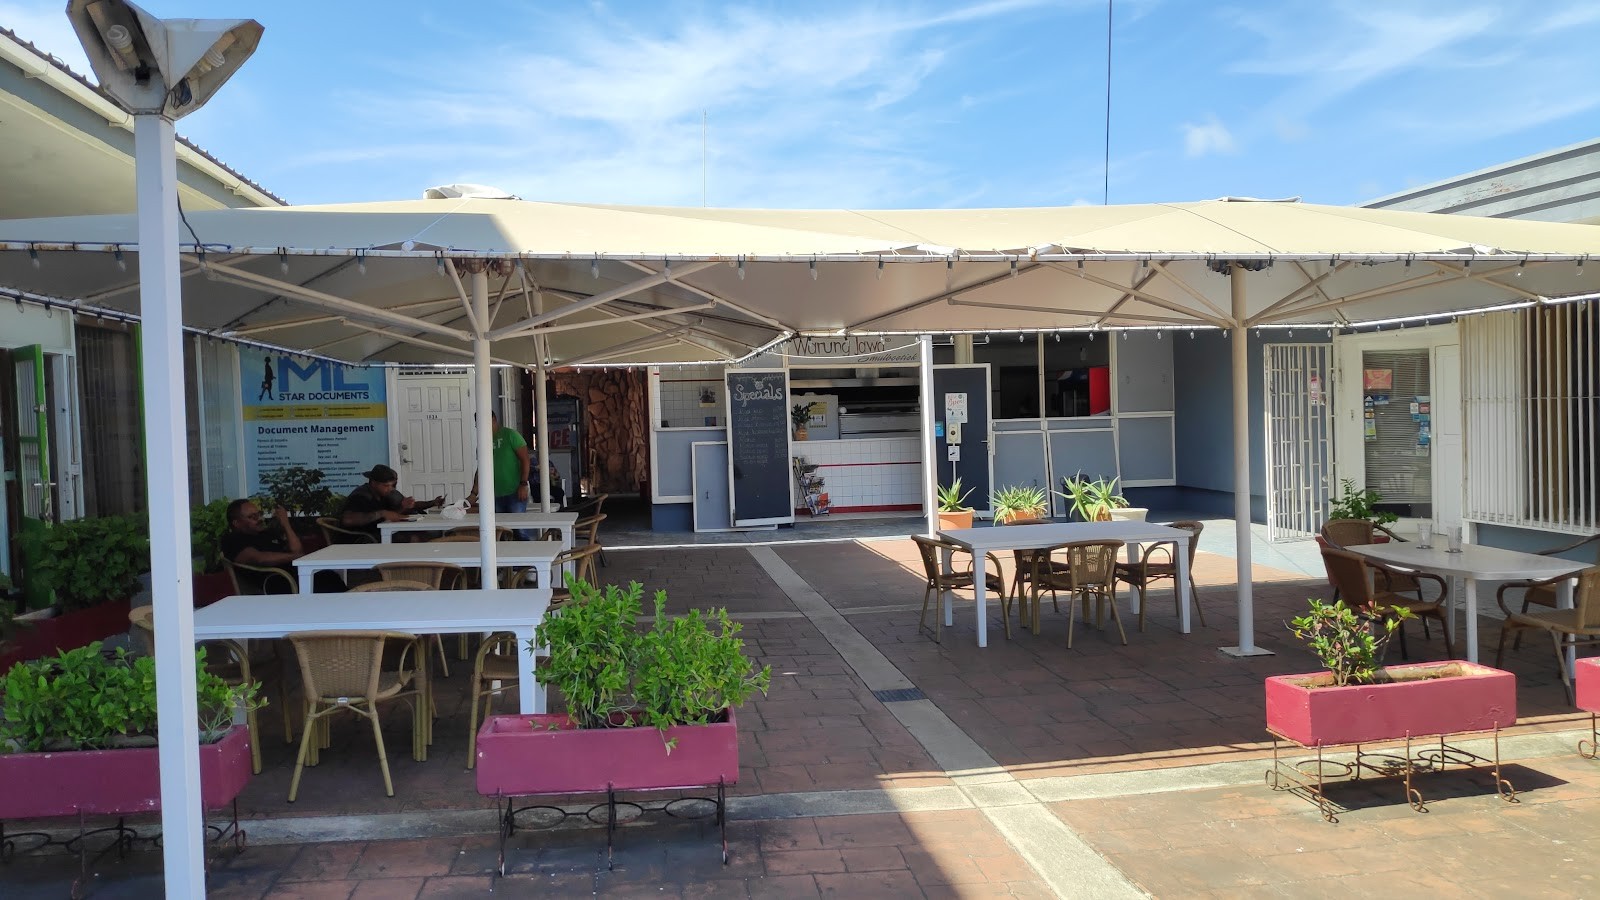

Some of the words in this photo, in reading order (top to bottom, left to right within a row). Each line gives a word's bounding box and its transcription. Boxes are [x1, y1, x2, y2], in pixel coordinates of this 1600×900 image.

[277, 356, 370, 392] ML
[279, 392, 305, 401] STAR
[308, 391, 370, 400] DOCUMENTS
[733, 383, 783, 407] Specials
[258, 426, 308, 434] Document
[311, 424, 375, 435] Management
